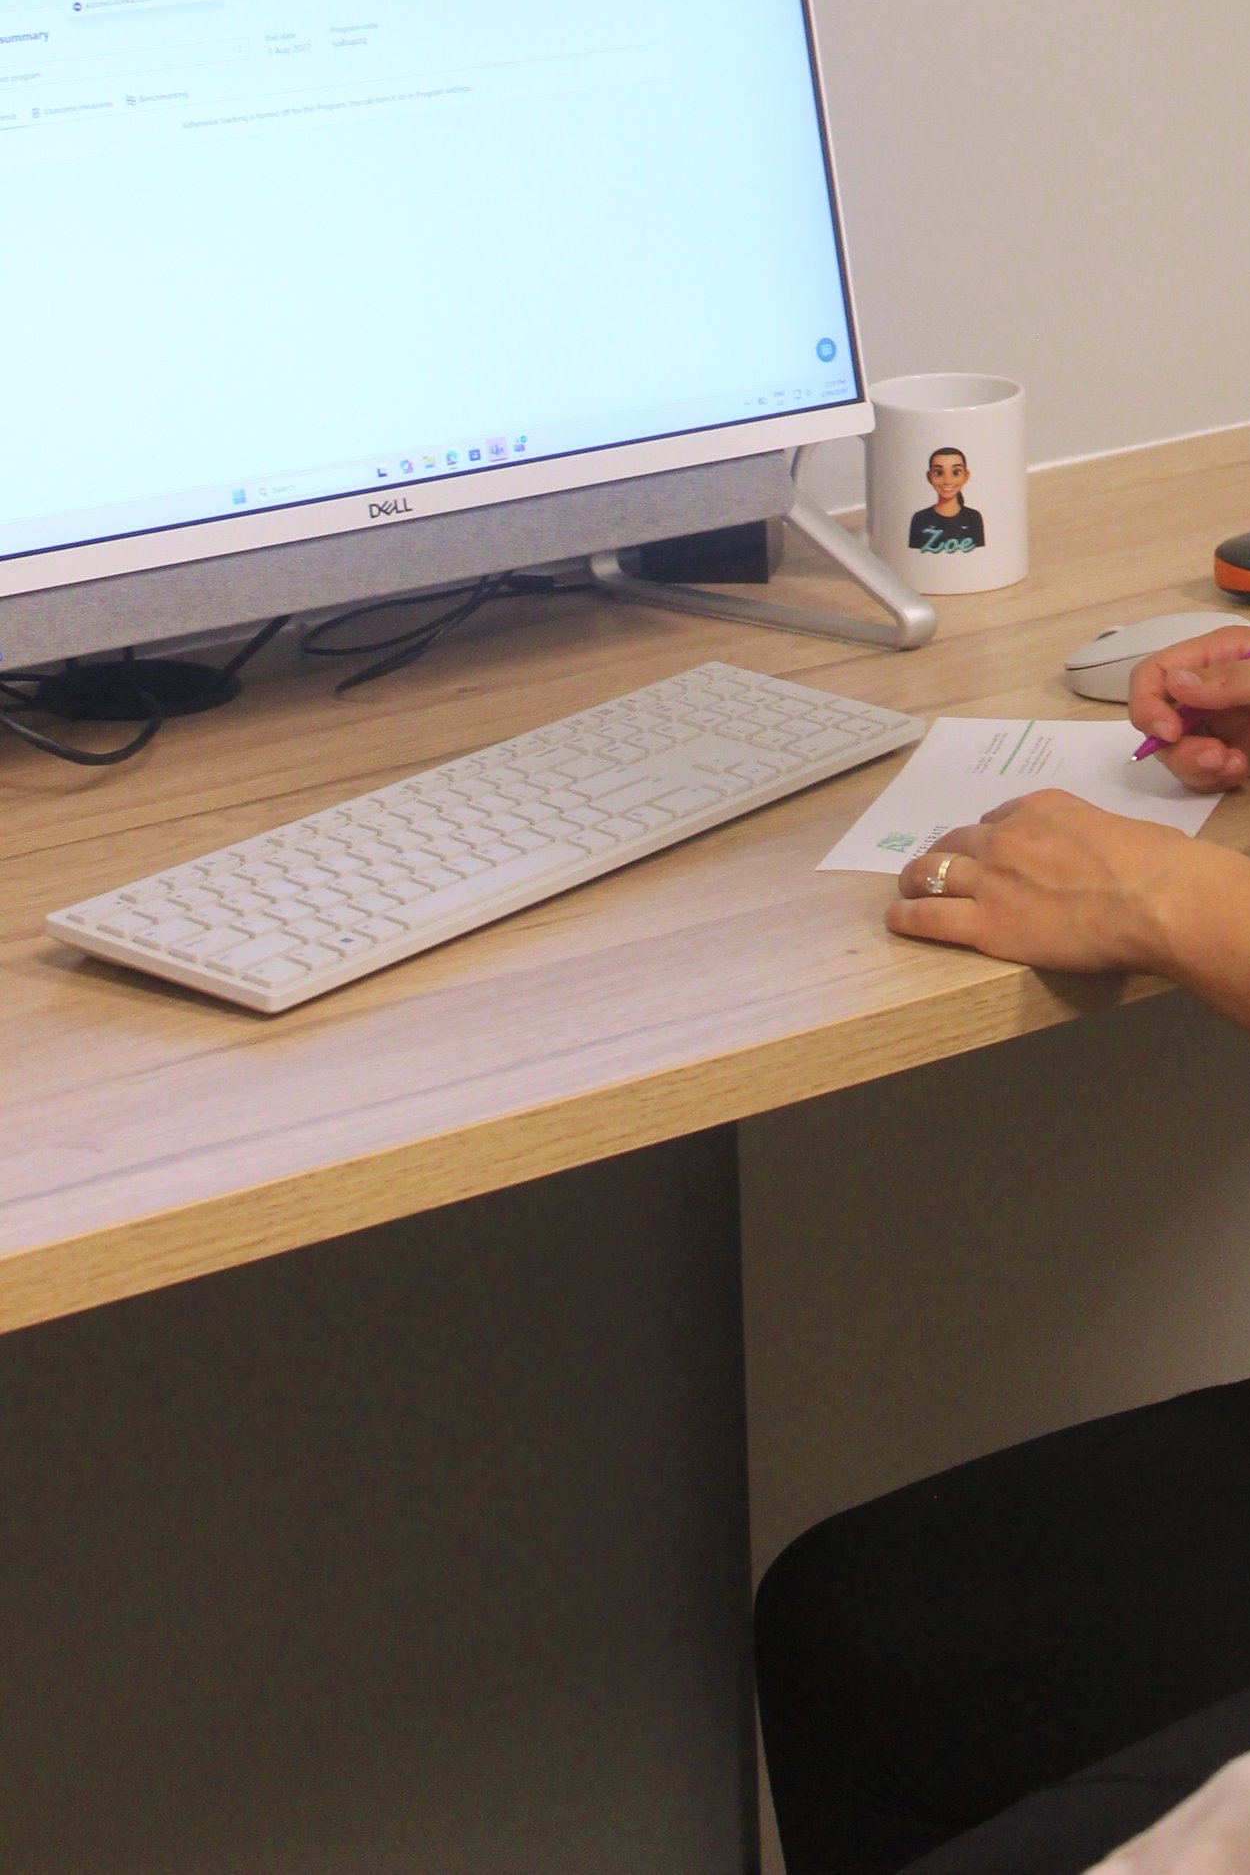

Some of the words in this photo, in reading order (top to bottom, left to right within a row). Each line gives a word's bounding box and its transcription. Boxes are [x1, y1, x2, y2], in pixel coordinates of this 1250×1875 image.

[0, 30, 50, 44] summary
[368, 497, 413, 519] DELL
[920, 525, 977, 554] Zoe
